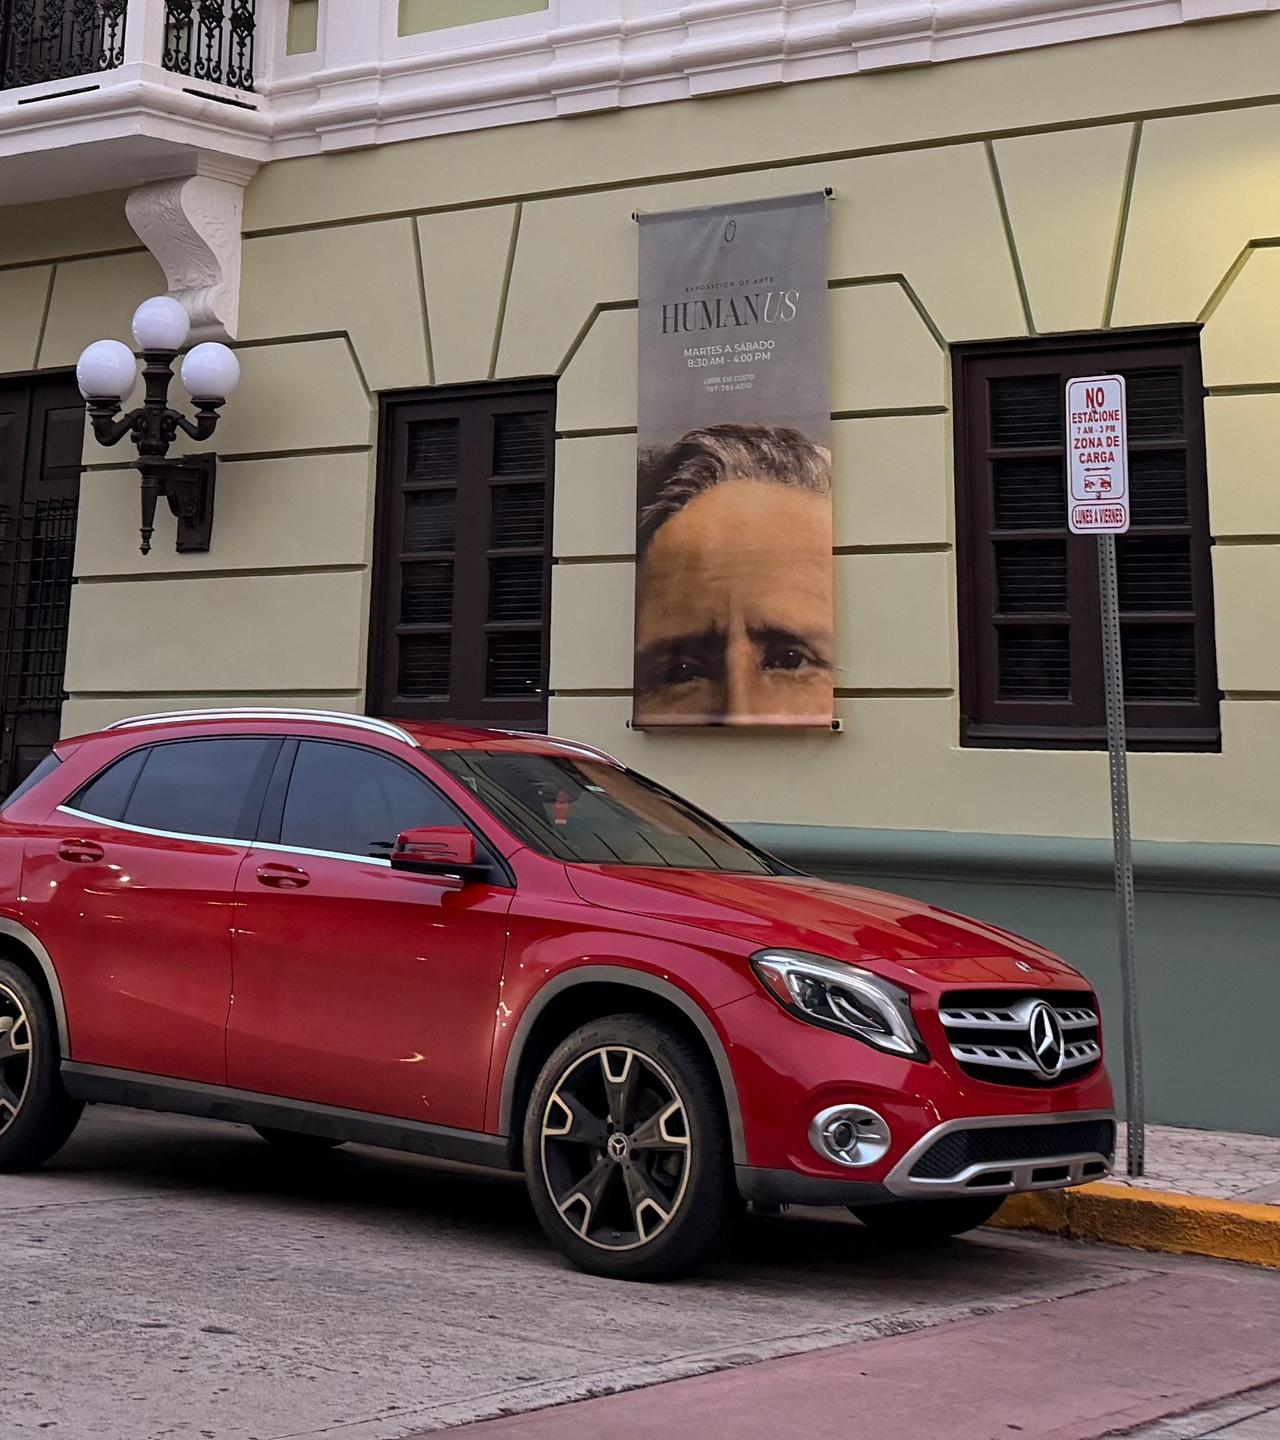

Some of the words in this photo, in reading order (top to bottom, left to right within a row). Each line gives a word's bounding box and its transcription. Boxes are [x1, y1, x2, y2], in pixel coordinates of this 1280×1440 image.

[662, 290, 799, 334] HUMANUS
[684, 345, 723, 357] MARTES
[724, 344, 733, 353] A
[687, 358, 708, 368] 8:30
[710, 356, 725, 366] AM
[733, 353, 754, 364] 4:00
[754, 352, 771, 361] PM
[1085, 386, 1105, 408] NO
[1071, 409, 1120, 424] ESTACIONE
[1077, 426, 1081, 434] 7
[1083, 425, 1094, 434] AM
[1099, 425, 1104, 433] 3
[1105, 424, 1116, 433] PM
[1073, 436, 1104, 450] ZONA
[1106, 435, 1121, 448] DE
[1079, 452, 1115, 464] CARGA
[1074, 509, 1093, 525] LUNES
[1093, 508, 1098, 524] A
[1098, 507, 1123, 524] VIERNES
